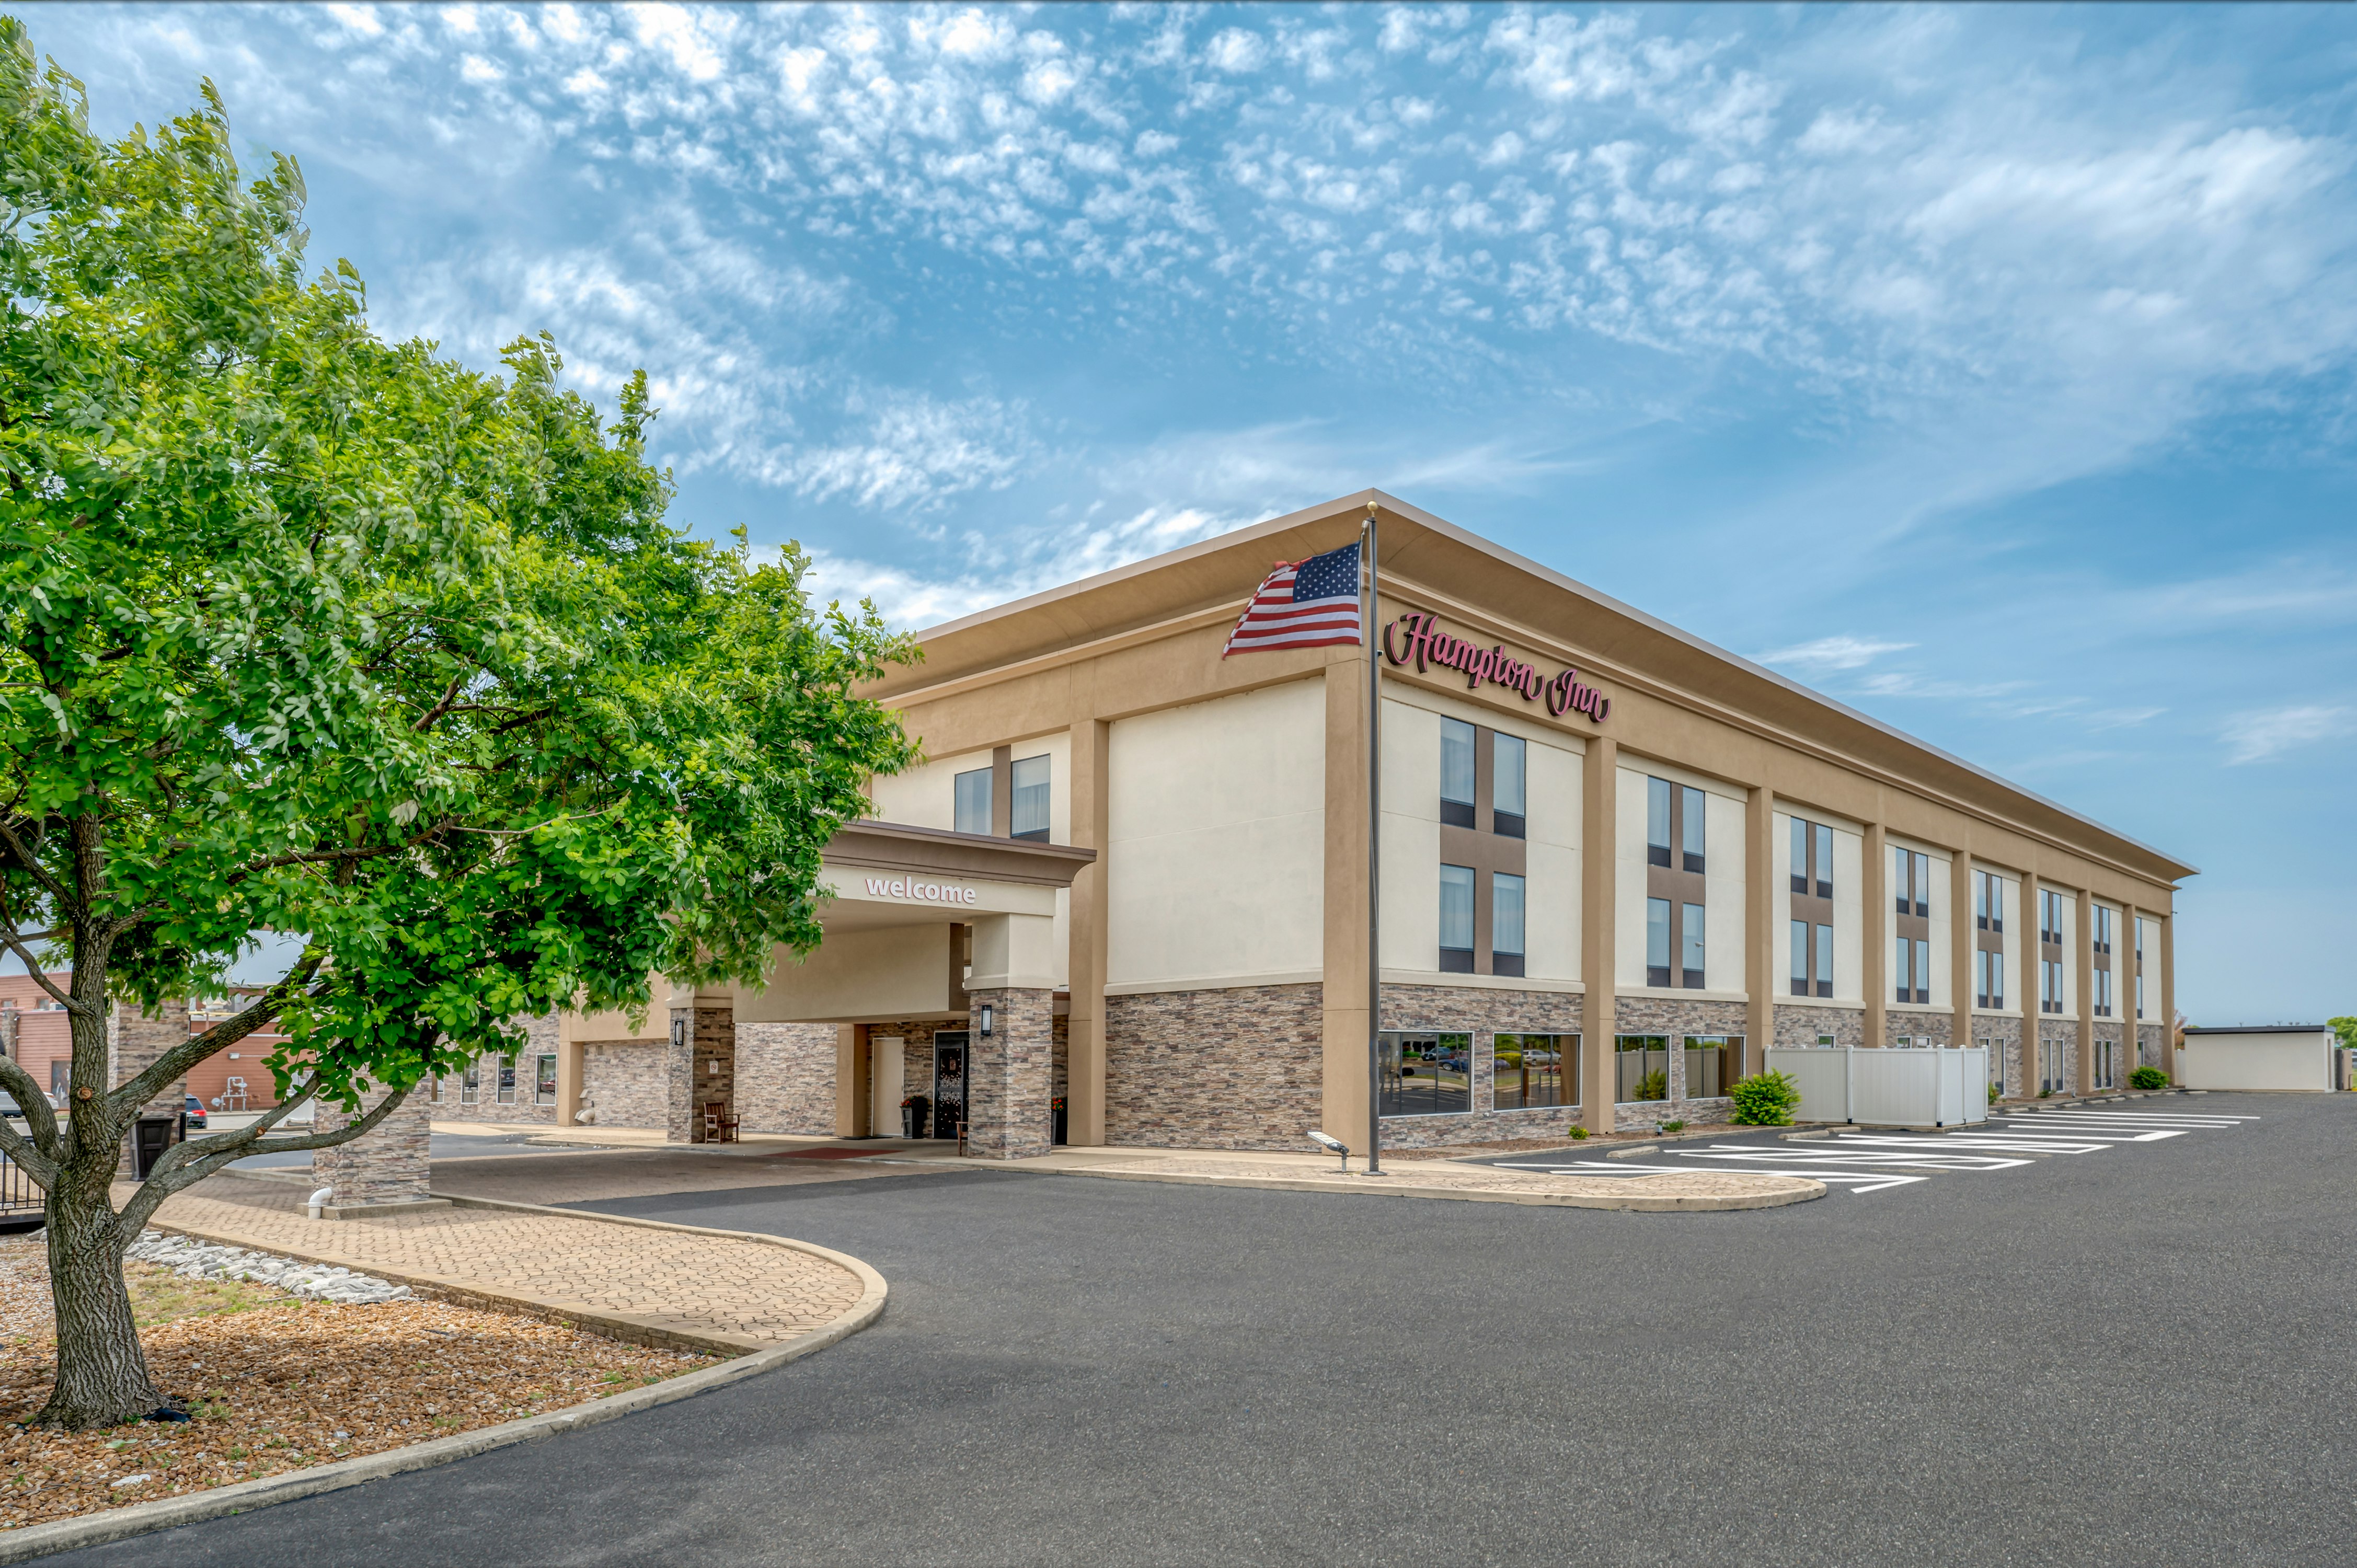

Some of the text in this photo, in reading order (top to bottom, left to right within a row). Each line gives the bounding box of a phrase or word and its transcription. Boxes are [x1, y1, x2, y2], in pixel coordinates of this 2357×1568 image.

[1383, 613, 1611, 723] Hampton Inn
[865, 876, 976, 904] welcome
